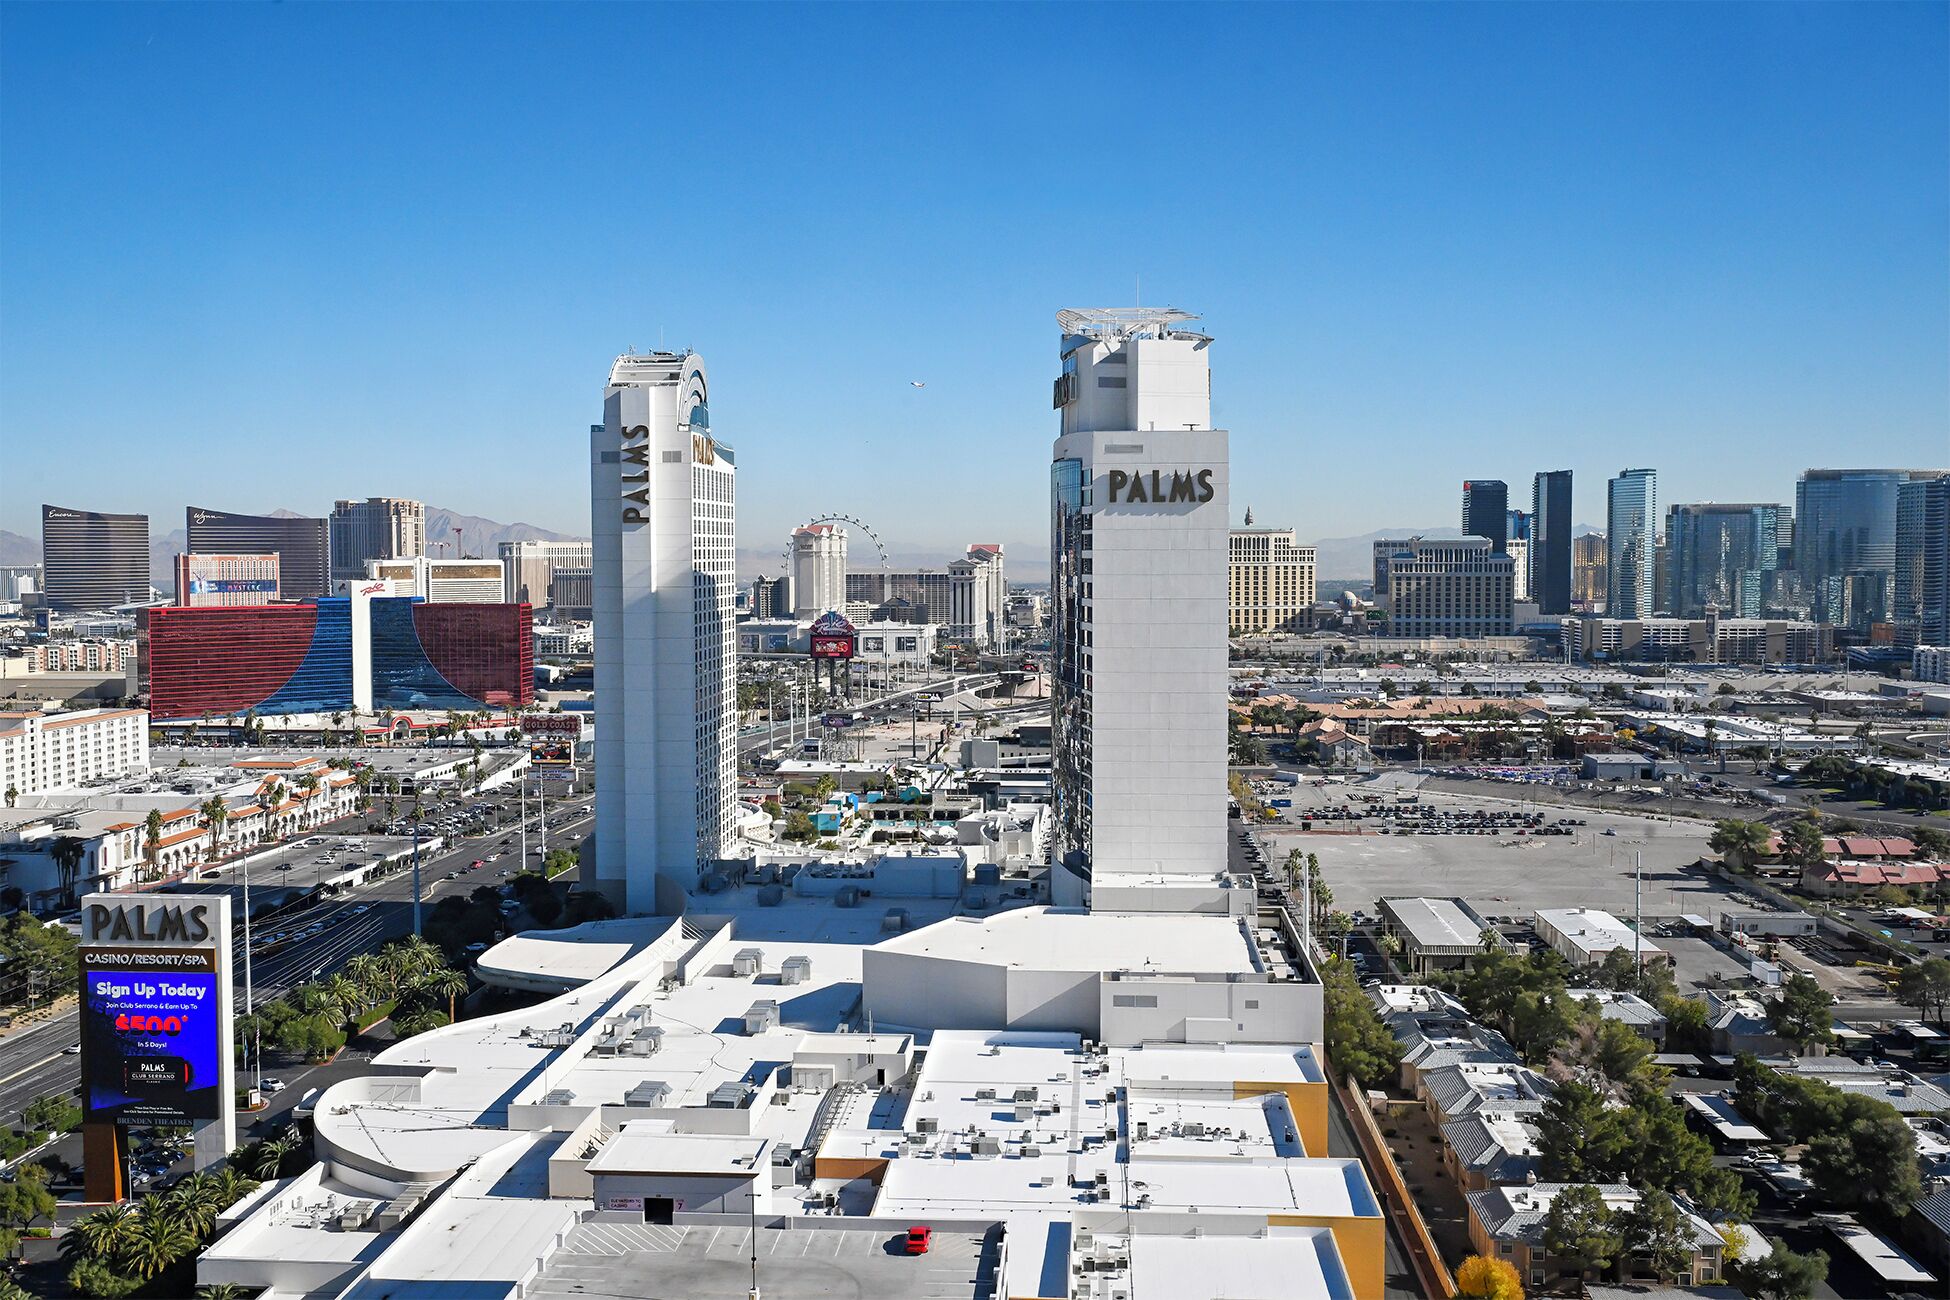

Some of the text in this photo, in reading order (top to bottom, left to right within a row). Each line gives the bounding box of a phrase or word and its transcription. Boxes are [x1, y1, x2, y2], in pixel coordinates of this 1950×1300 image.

[621, 425, 650, 524] PALMS
[1109, 468, 1215, 503] PALMS
[49, 509, 81, 518] Encore
[525, 721, 577, 729] GOLD COAST
[91, 904, 209, 942] PALMS
[84, 953, 208, 967] CASINO/RESORT/SPA
[96, 981, 207, 1000] Sign Up Today
[149, 1041, 167, 1049] Days!
[141, 1063, 165, 1071] PALMS
